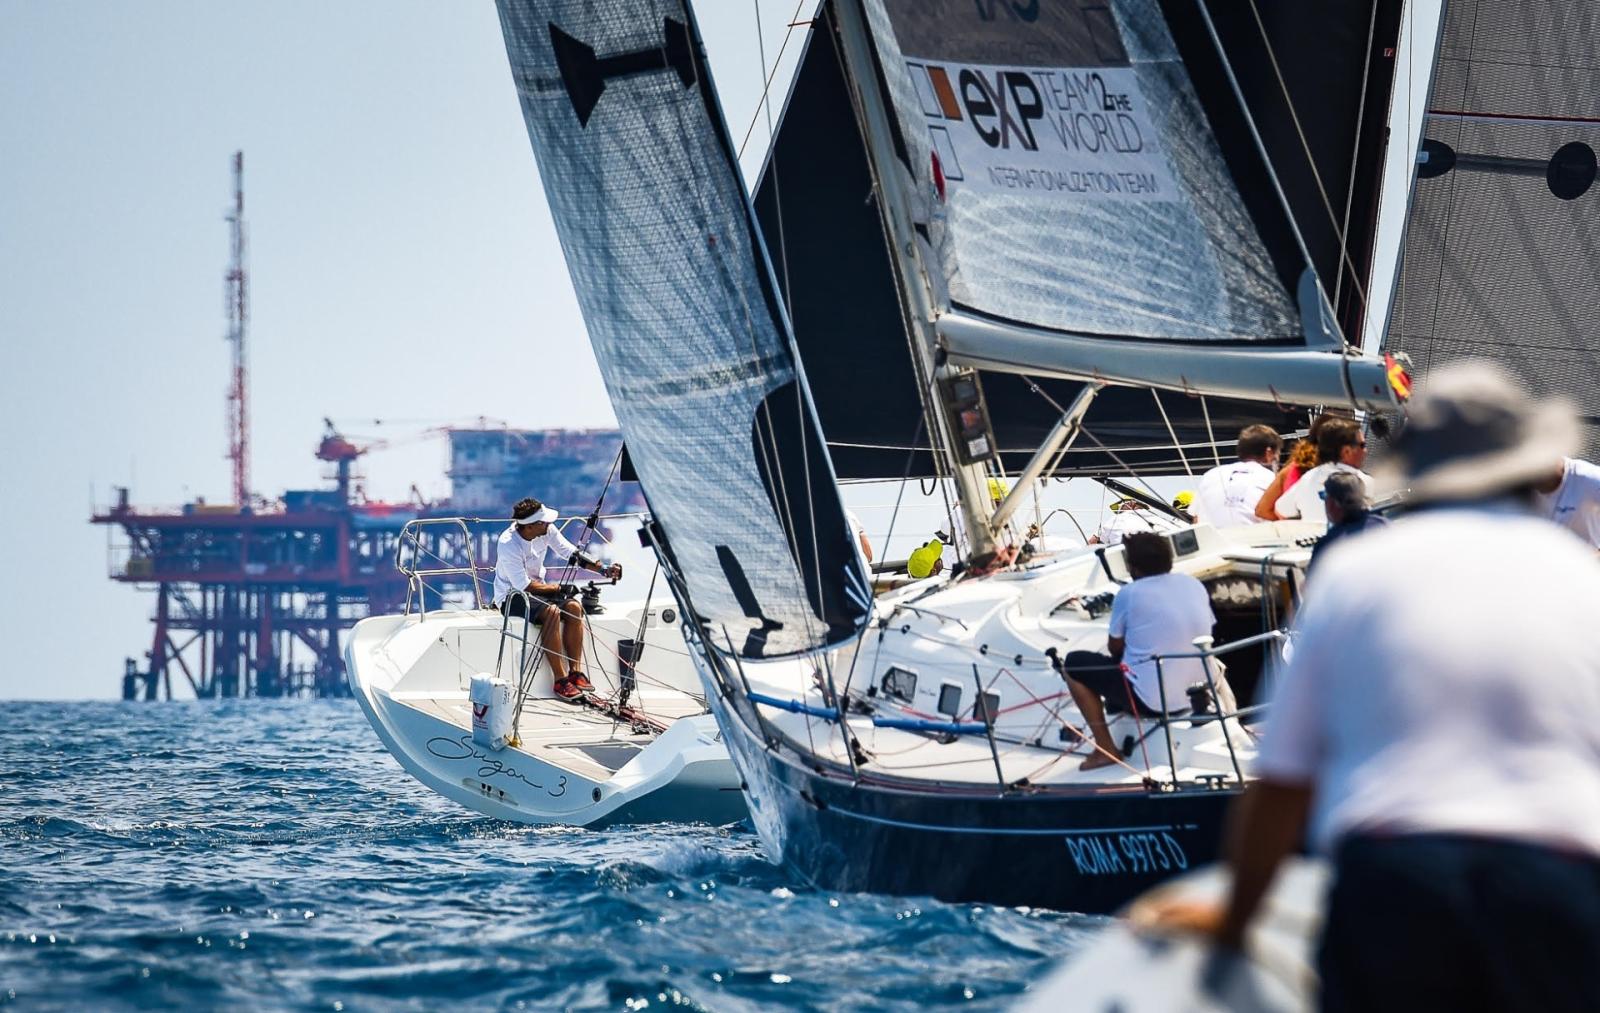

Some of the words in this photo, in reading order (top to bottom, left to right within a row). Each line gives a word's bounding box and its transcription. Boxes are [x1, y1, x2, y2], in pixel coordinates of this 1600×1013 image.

[1047, 112, 1143, 153] WORLD
[1118, 172, 1158, 194] TEAM
[426, 735, 543, 789] Sugar
[548, 775, 567, 797] 3
[1065, 836, 1127, 875] ROMA
[1119, 833, 1170, 873] 9973
[1161, 831, 1188, 870] D
